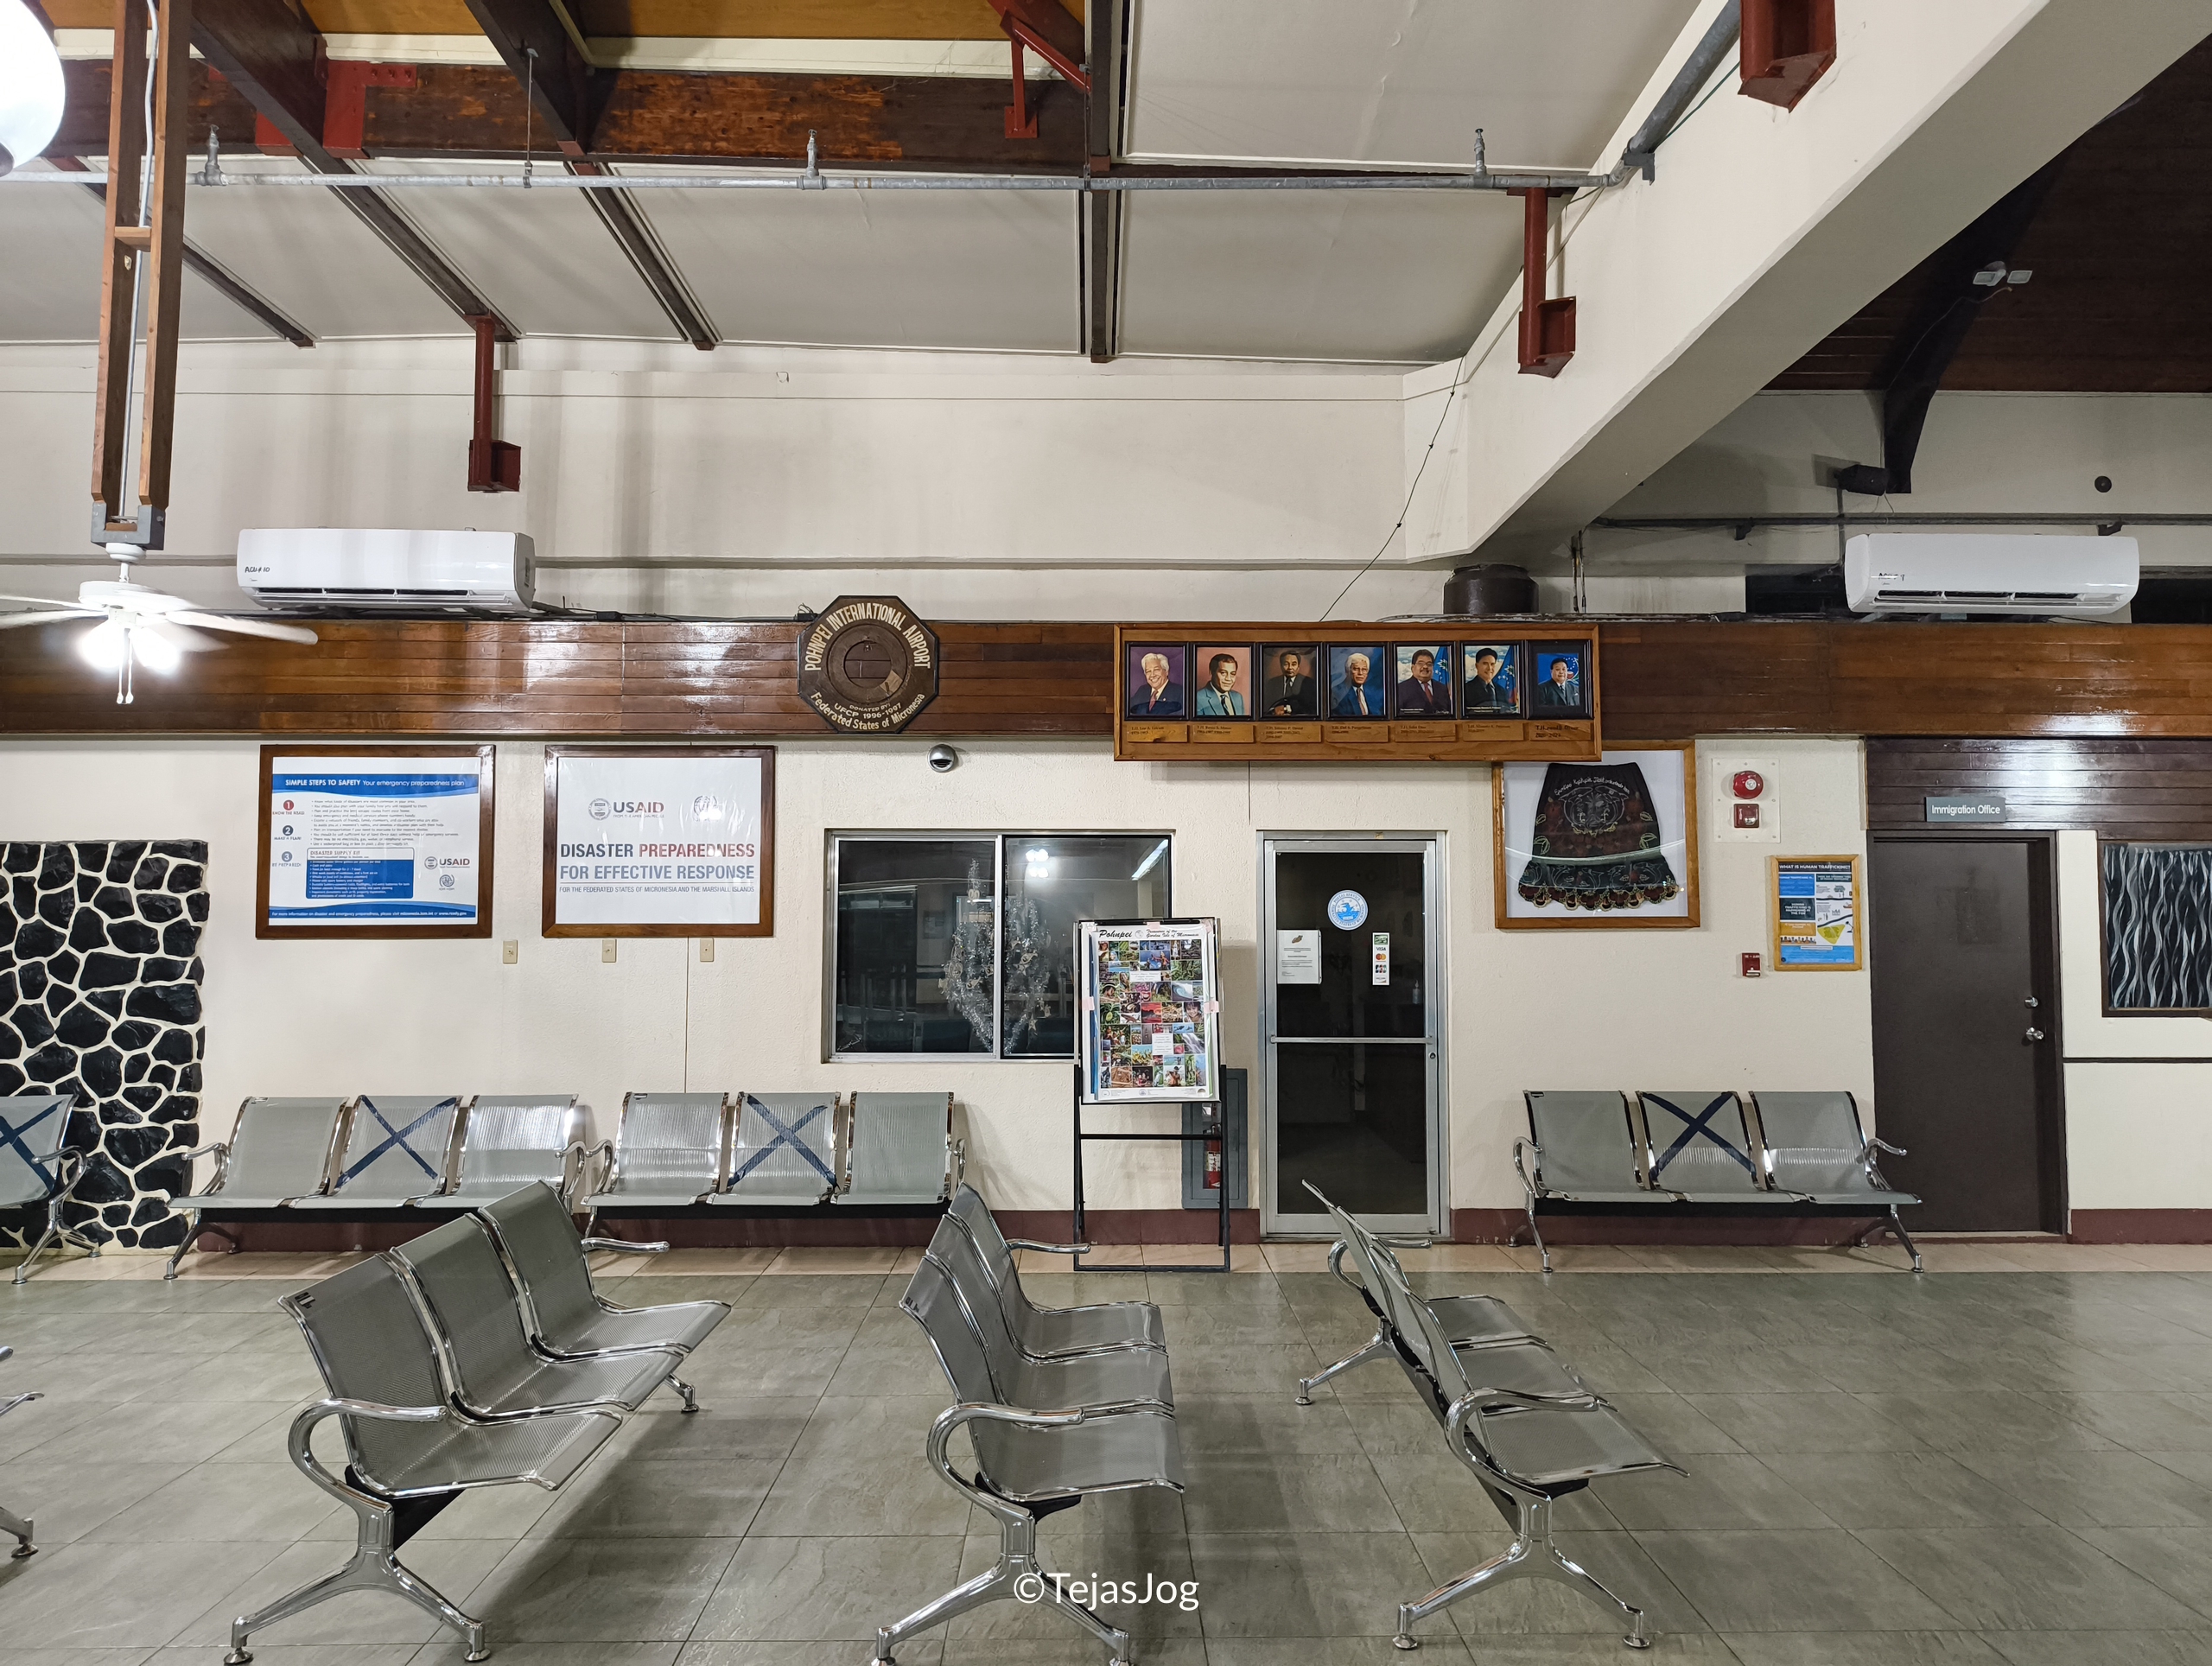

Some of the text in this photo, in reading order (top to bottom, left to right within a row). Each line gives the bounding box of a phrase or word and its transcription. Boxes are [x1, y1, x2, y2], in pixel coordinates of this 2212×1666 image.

[805, 602, 931, 671] POHNPEI INTERNATIONAL AIRPORT
[810, 691, 925, 730] Federated States of Micronesia
[834, 703, 902, 719] UFCP 1996-1997
[613, 802, 664, 813] USAID
[1931, 804, 2000, 816] Immigration Office
[560, 843, 755, 857] DISASTER PREPAREDNESS
[560, 865, 754, 880] FOR EFFECTIVE RESPONSE
[1099, 929, 1132, 939] Pohnpei
